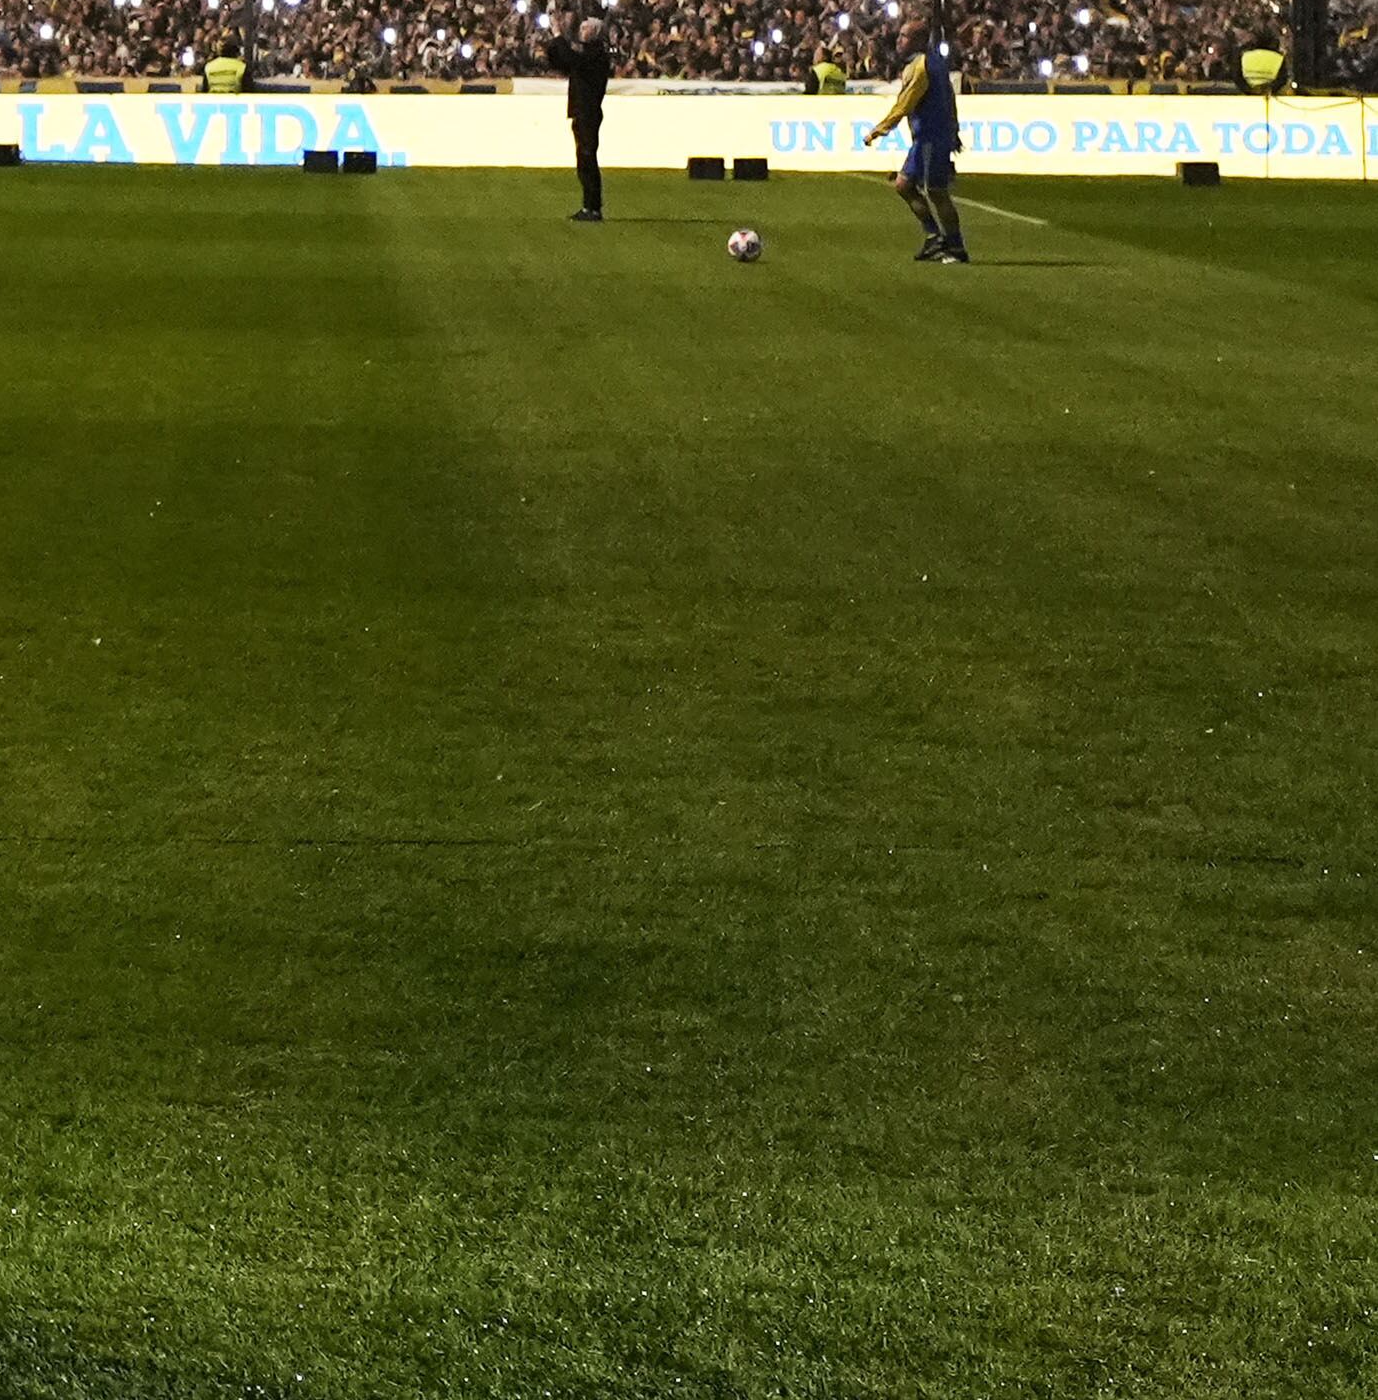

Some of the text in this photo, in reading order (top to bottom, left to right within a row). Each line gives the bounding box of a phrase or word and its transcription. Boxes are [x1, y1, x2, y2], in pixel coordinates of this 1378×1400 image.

[16, 102, 134, 164] LA
[154, 103, 407, 167] VIDA.
[769, 120, 835, 152] UN
[850, 120, 1057, 153] PATIDO
[1074, 122, 1201, 154] PARA
[1212, 123, 1353, 156] TODA
